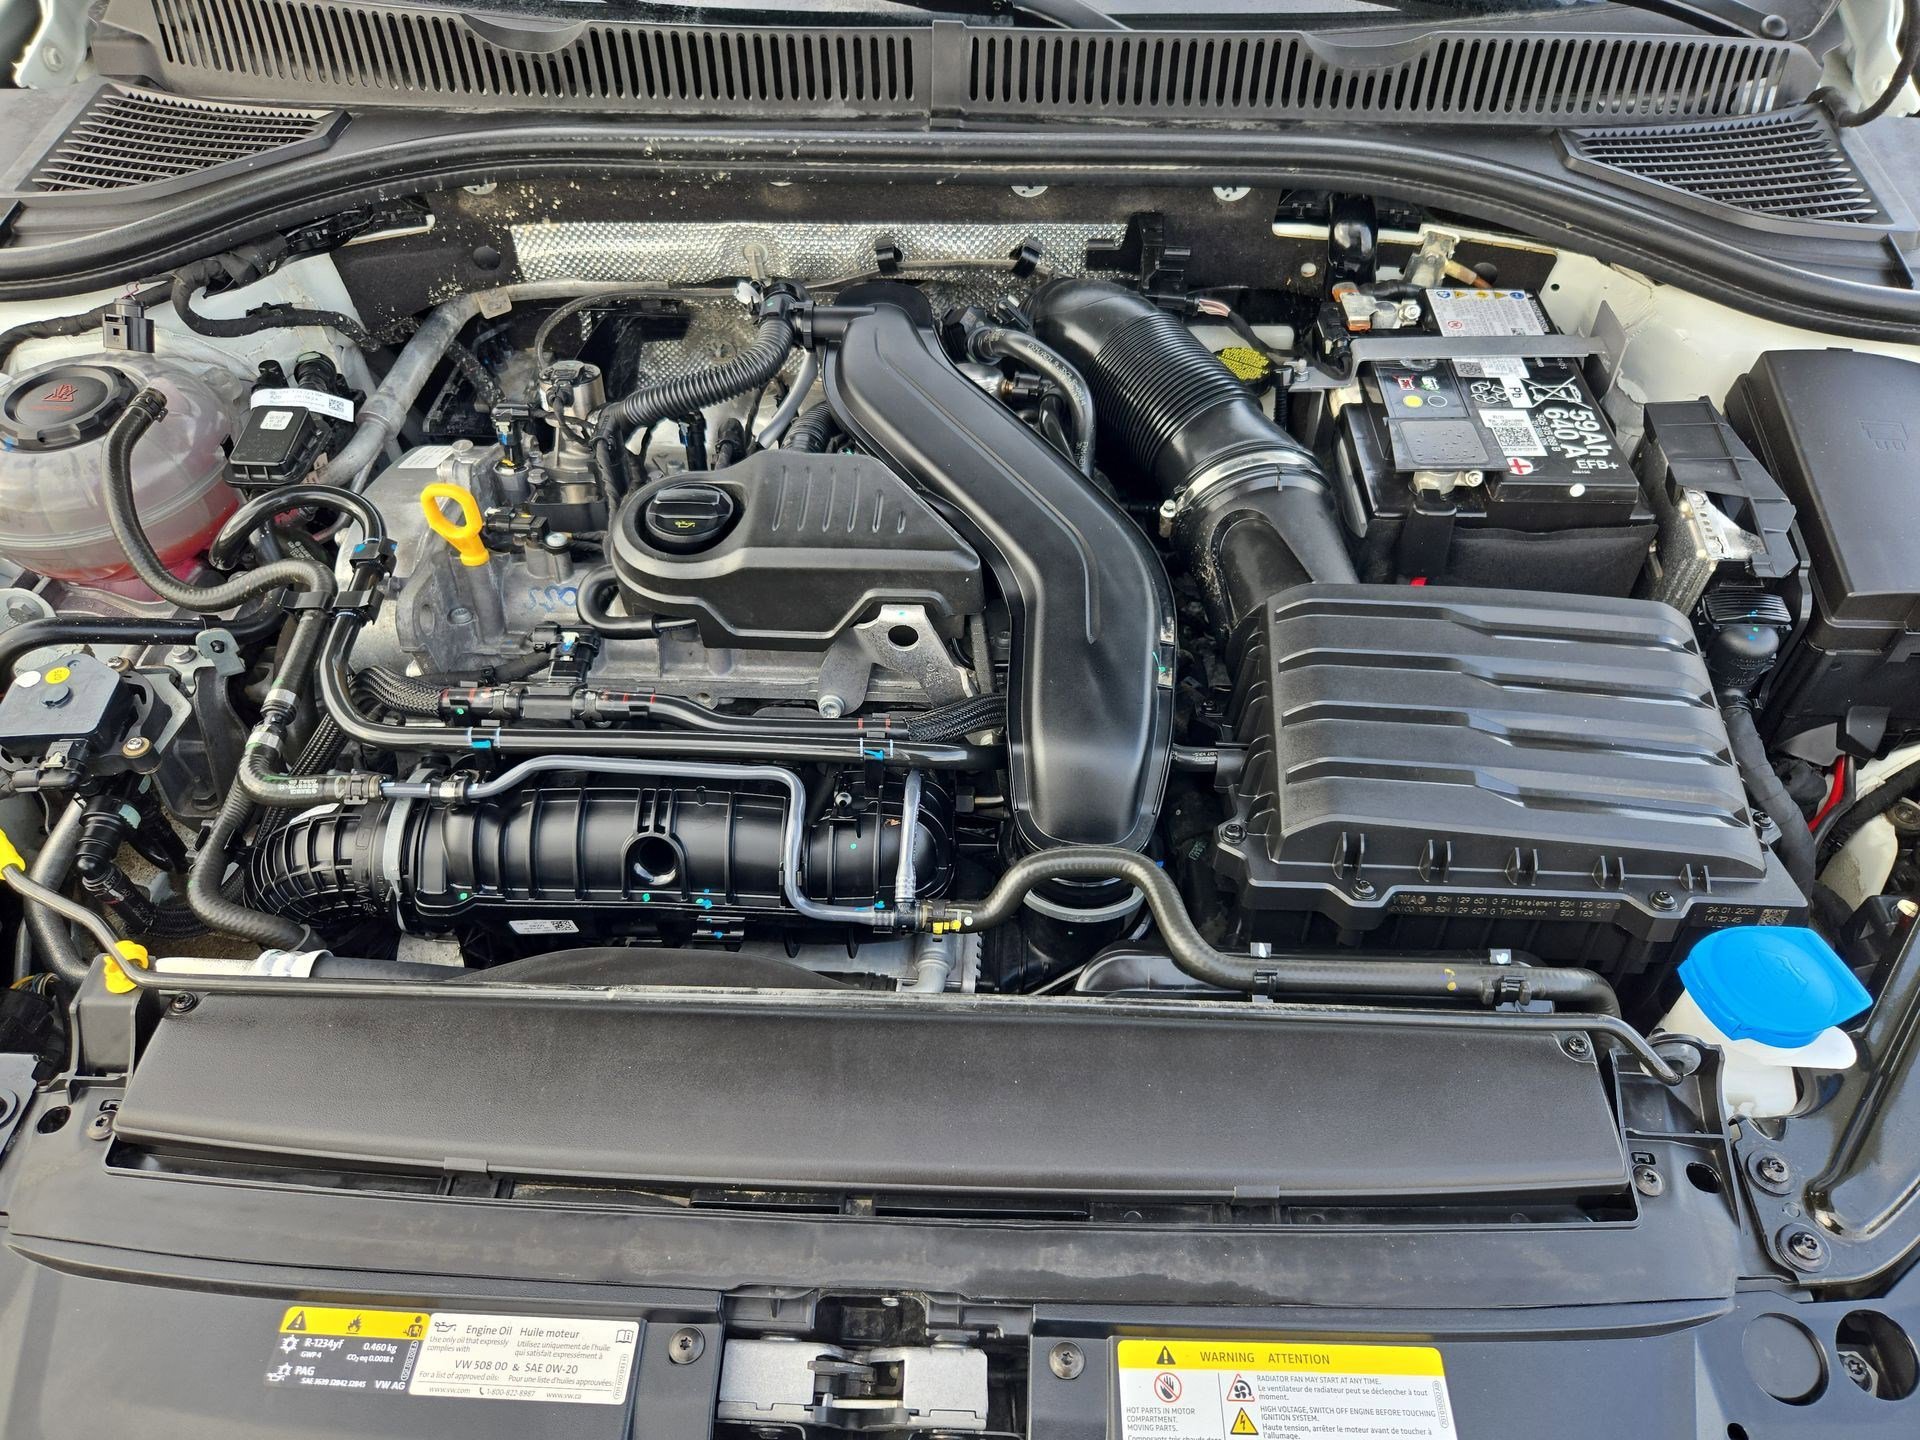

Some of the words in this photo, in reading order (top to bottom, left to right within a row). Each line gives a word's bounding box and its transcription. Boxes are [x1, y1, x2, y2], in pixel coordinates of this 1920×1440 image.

[1509, 387, 1522, 398] Pb
[1543, 407, 1580, 440] 640
[1569, 408, 1613, 457] 59Ah
[1560, 443, 1588, 458] A
[1576, 460, 1619, 470] EFB+
[1457, 896, 1471, 904] 129
[1473, 897, 1488, 905] 601
[1501, 898, 1557, 907] Filterelement
[1579, 901, 1593, 909] 129
[1455, 906, 1469, 914] 129
[1471, 907, 1487, 915] 607
[1706, 906, 1757, 915] 24.01.2025
[466, 1325, 498, 1336] Engine
[499, 1326, 513, 1336] Oil
[520, 1327, 544, 1337] Huile
[545, 1329, 580, 1339] moteur
[304, 1338, 345, 1351] R-1234yf
[441, 1336, 456, 1345] only
[479, 1338, 509, 1347] expressly
[517, 1340, 541, 1348] Utilisez
[542, 1341, 581, 1350] uniquement
[581, 1343, 590, 1351] de
[363, 1343, 386, 1352] 0.460
[387, 1344, 398, 1354] kg
[427, 1344, 455, 1353] complies
[514, 1349, 526, 1357] qui
[526, 1349, 552, 1357] satisfait
[552, 1350, 597, 1360] expressément
[1200, 1351, 1255, 1364] WARNING
[1268, 1353, 1330, 1365] ATTENTION
[294, 1366, 316, 1375] PAG
[455, 1360, 472, 1369] VW
[473, 1360, 493, 1371] 508
[494, 1361, 508, 1371] 00
[512, 1363, 520, 1372] &
[524, 1363, 544, 1372] SAE
[545, 1363, 579, 1374] 0W-20
[419, 1370, 430, 1378] For
[436, 1371, 446, 1379] list
[446, 1371, 454, 1379] of
[454, 1372, 486, 1381] approved
[508, 1374, 523, 1382] Pour
[537, 1376, 550, 1384] liste
[1256, 1375, 1289, 1383] RADIATOR
[1290, 1375, 1303, 1383] FAN
[1319, 1376, 1339, 1384] START
[1364, 1377, 1381, 1385] TIME.
[375, 1380, 391, 1389] VW
[391, 1381, 406, 1390] AG
[429, 1386, 471, 1394] www.vw.com
[1266, 1385, 1303, 1393] ventilateur
[1314, 1386, 1344, 1394] radiateur
[1345, 1388, 1361, 1396] peut
[1370, 1388, 1407, 1396] déclencher
[1162, 1407, 1170, 1415] IN
[1260, 1405, 1277, 1413] HIGH
[1277, 1406, 1309, 1414] VOLTAGE,
[1309, 1406, 1335, 1414] SWITCH
[1335, 1407, 1349, 1415] OFF
[1349, 1408, 1375, 1416] ENGINE
[1402, 1409, 1436, 1418] TOUCHING
[1126, 1415, 1179, 1423] COMPARTMENT.
[1261, 1413, 1291, 1421] IGNITION
[1291, 1414, 1320, 1422] SYSTEM.
[1155, 1424, 1179, 1432] PARTS.
[1262, 1423, 1283, 1431] Haute
[1284, 1424, 1311, 1433] tension,
[1312, 1424, 1336, 1433] arrêter
[1391, 1427, 1400, 1435] de
[1400, 1428, 1426, 1436] toucher
